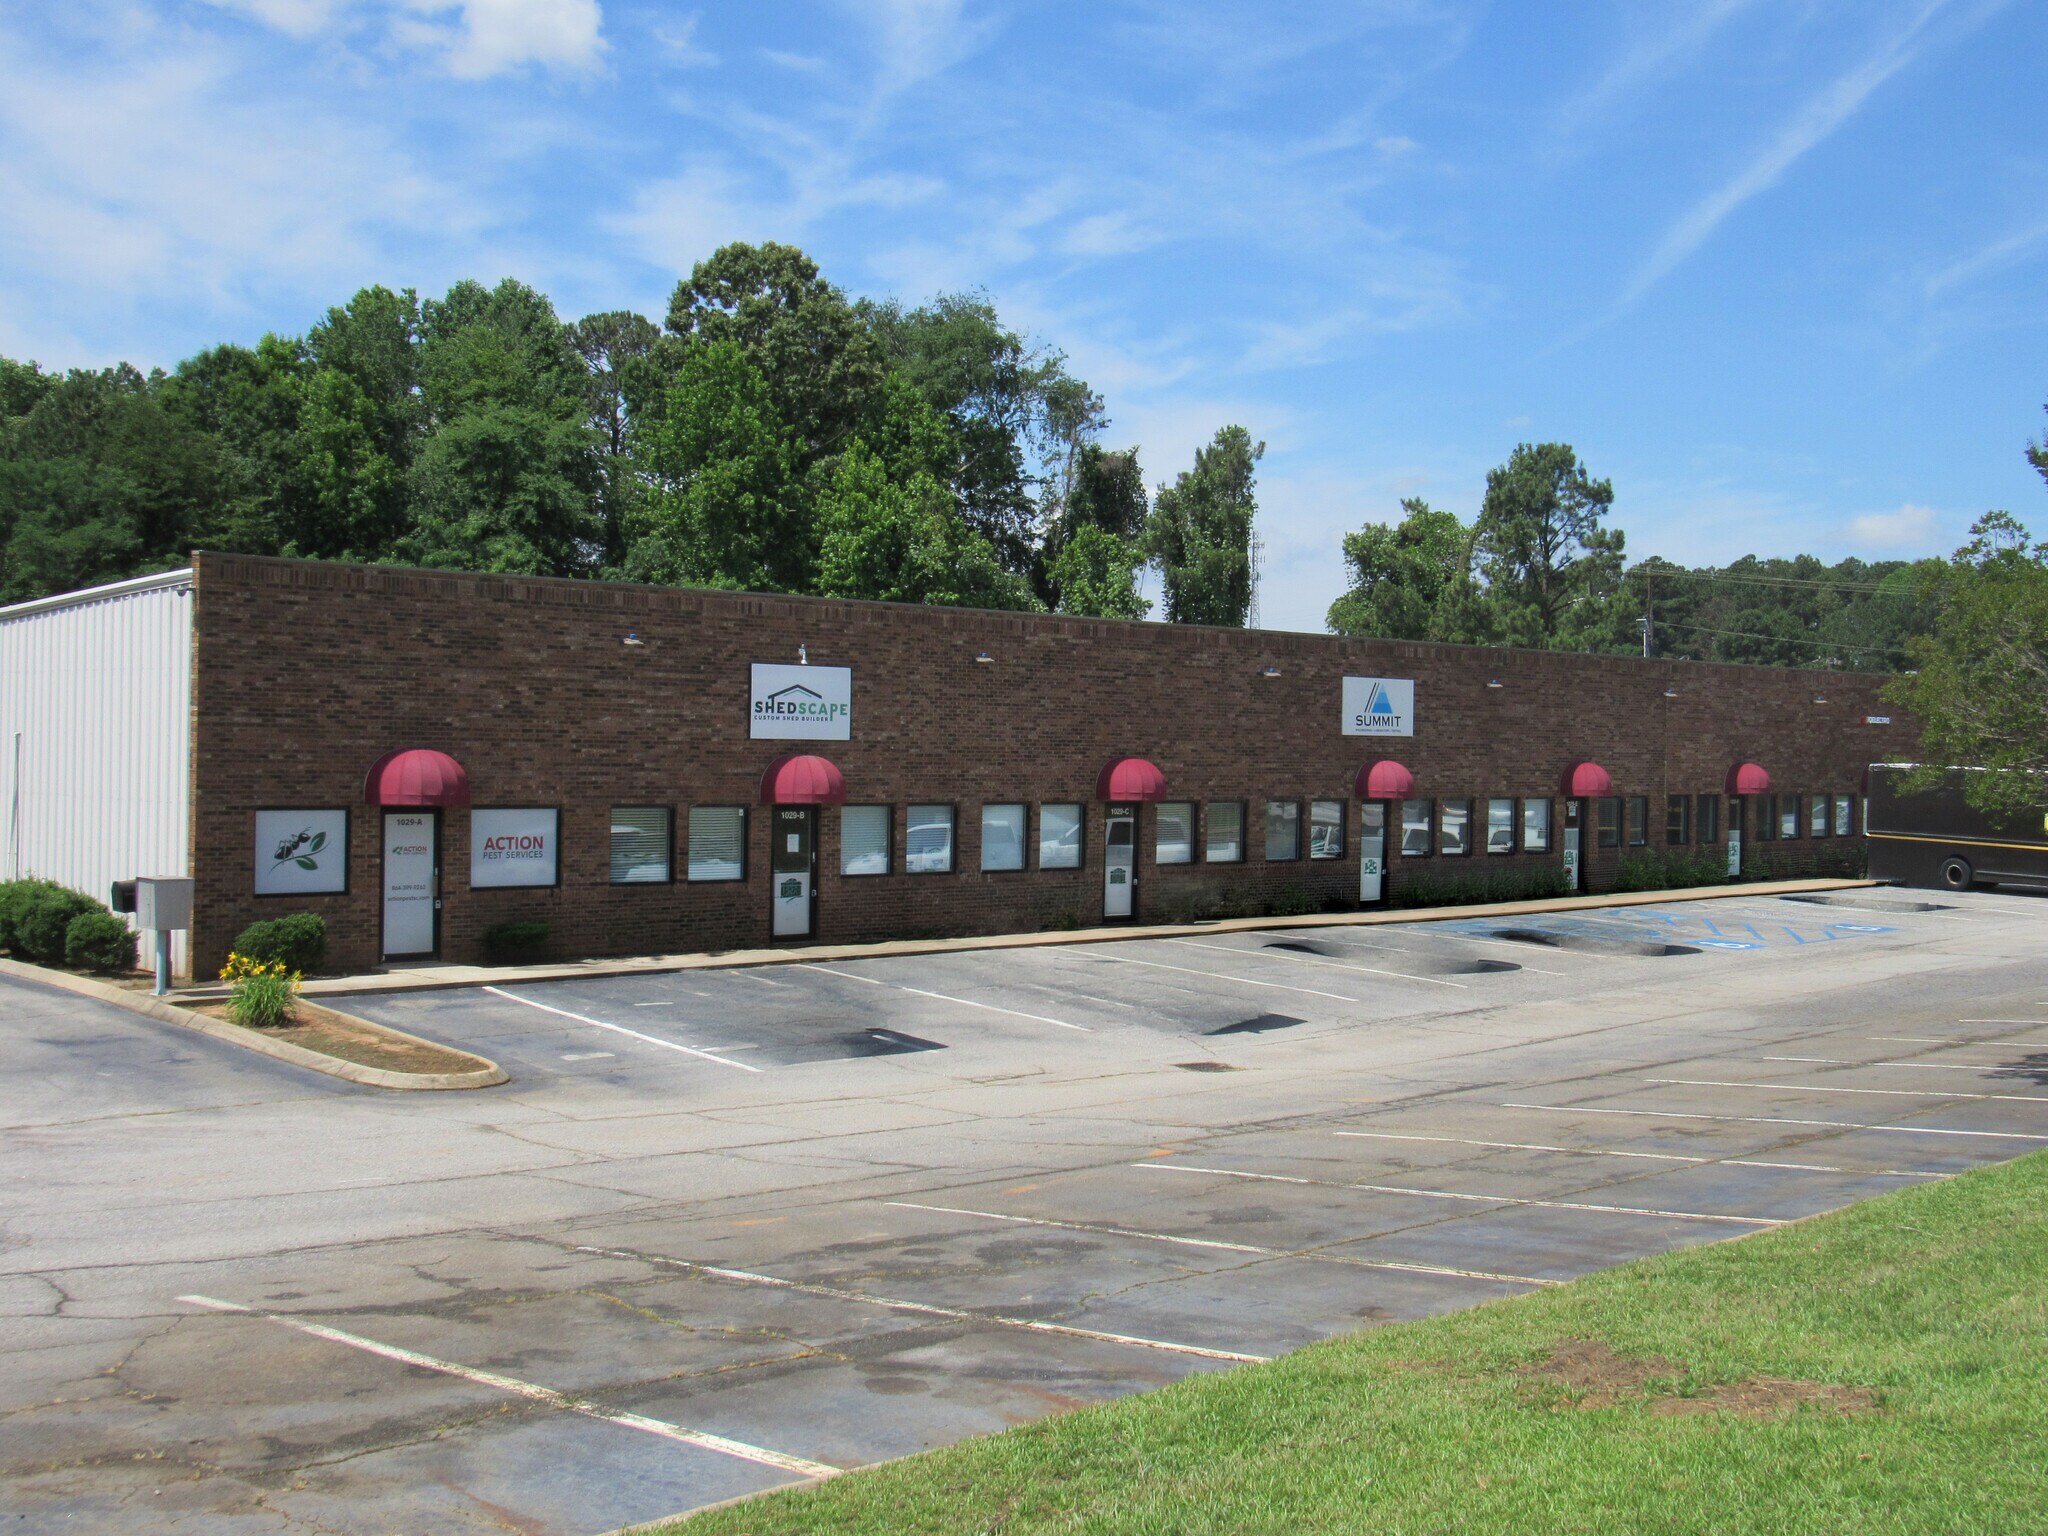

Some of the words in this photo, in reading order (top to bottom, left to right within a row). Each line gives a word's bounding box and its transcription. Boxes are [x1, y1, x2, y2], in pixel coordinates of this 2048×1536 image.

[754, 699, 848, 722] SHEDSCAPE
[1355, 714, 1402, 727] SUMMIT
[781, 811, 805, 819] 1029-B
[1110, 807, 1130, 815] 1029-C
[396, 818, 423, 826] 1029-A
[483, 836, 544, 850] ACTION
[482, 851, 503, 860] PEST
[505, 850, 544, 859] SERVICES
